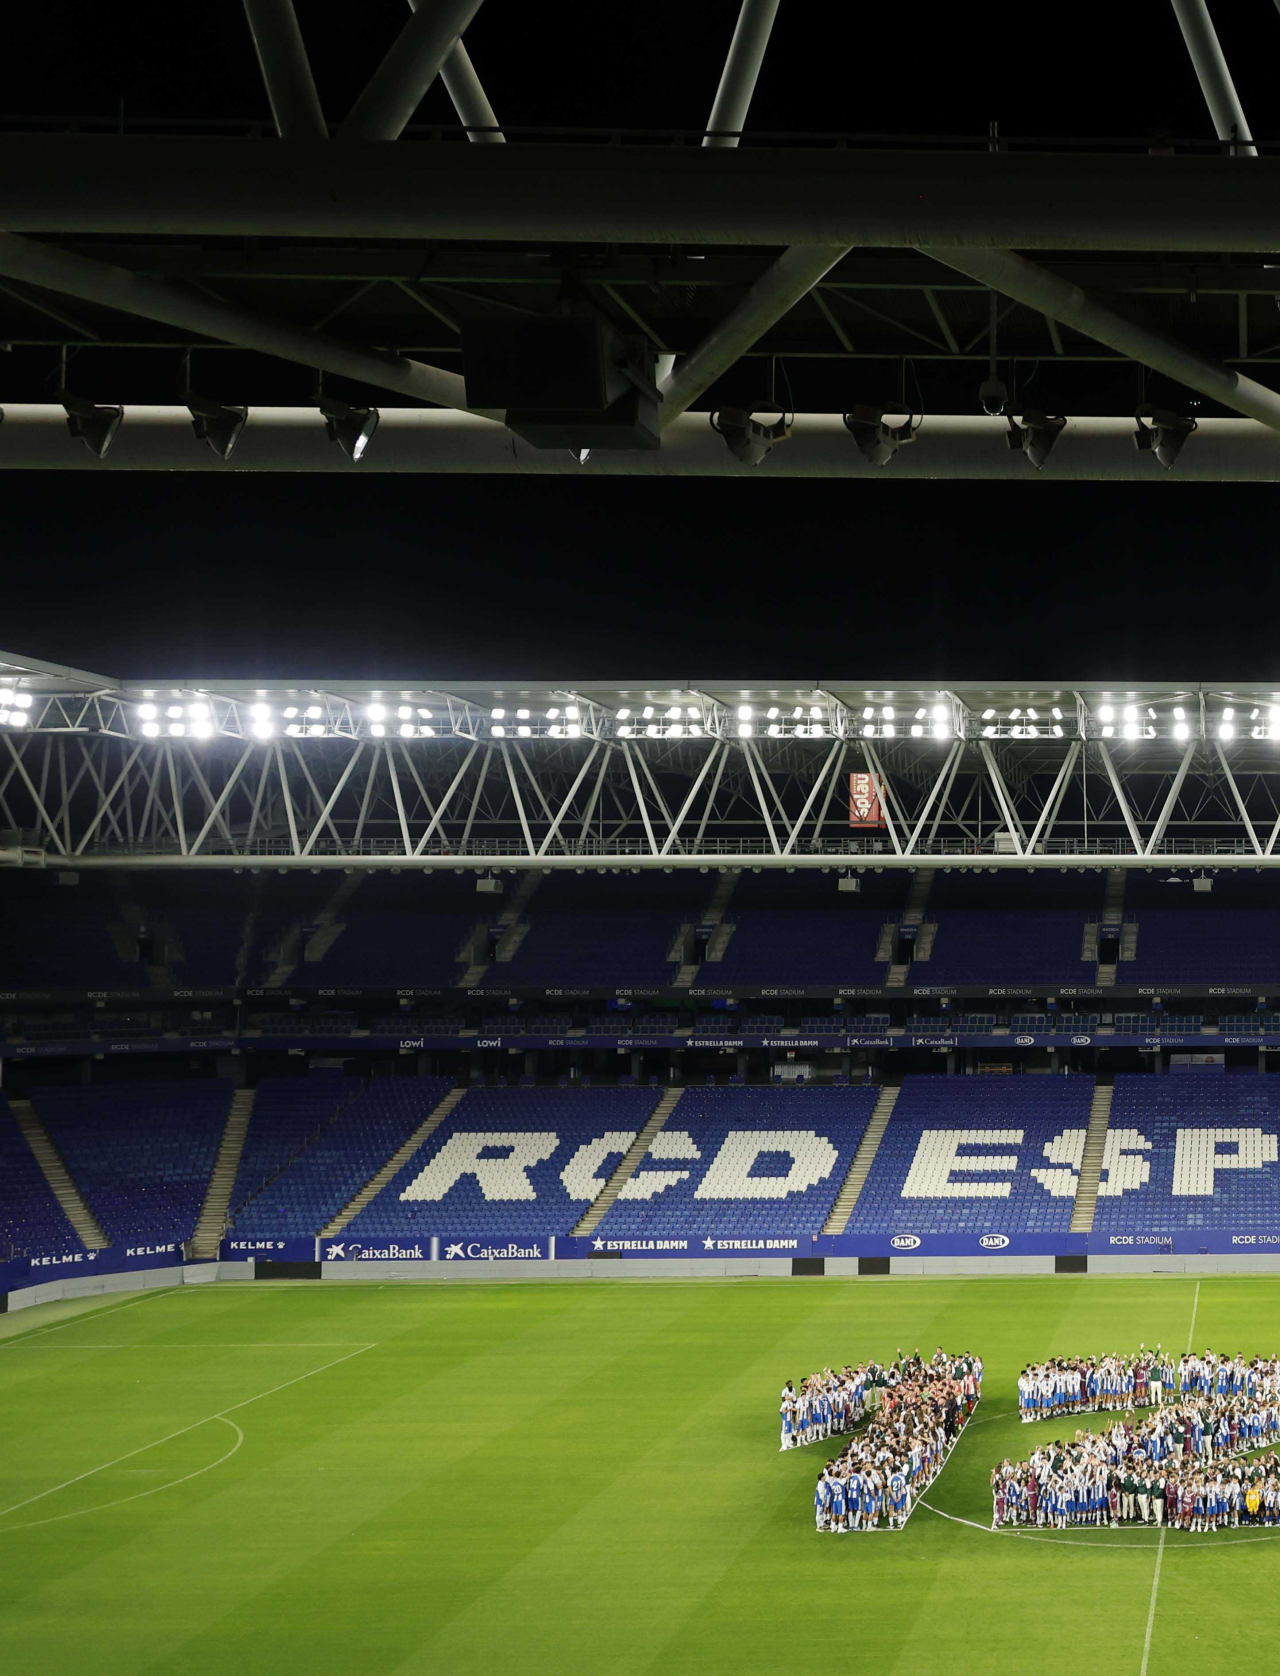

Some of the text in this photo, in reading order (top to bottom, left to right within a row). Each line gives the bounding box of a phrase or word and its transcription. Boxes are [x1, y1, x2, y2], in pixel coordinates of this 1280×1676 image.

[400, 1131, 838, 1201] RCD
[717, 1239, 797, 1249] ESTRELLA DAMM
[894, 1238, 914, 1246] DANI
[983, 1237, 1002, 1245] DANI
[1110, 1236, 1172, 1245] RCDE STADIUM
[1232, 1235, 1256, 1244] RCDE
[230, 1241, 273, 1249] KELME
[607, 1240, 687, 1250] ESTRELLA DAMM
[126, 1244, 175, 1257] KELME
[467, 1244, 541, 1258] CaixaBank
[31, 1253, 83, 1266] KELME
